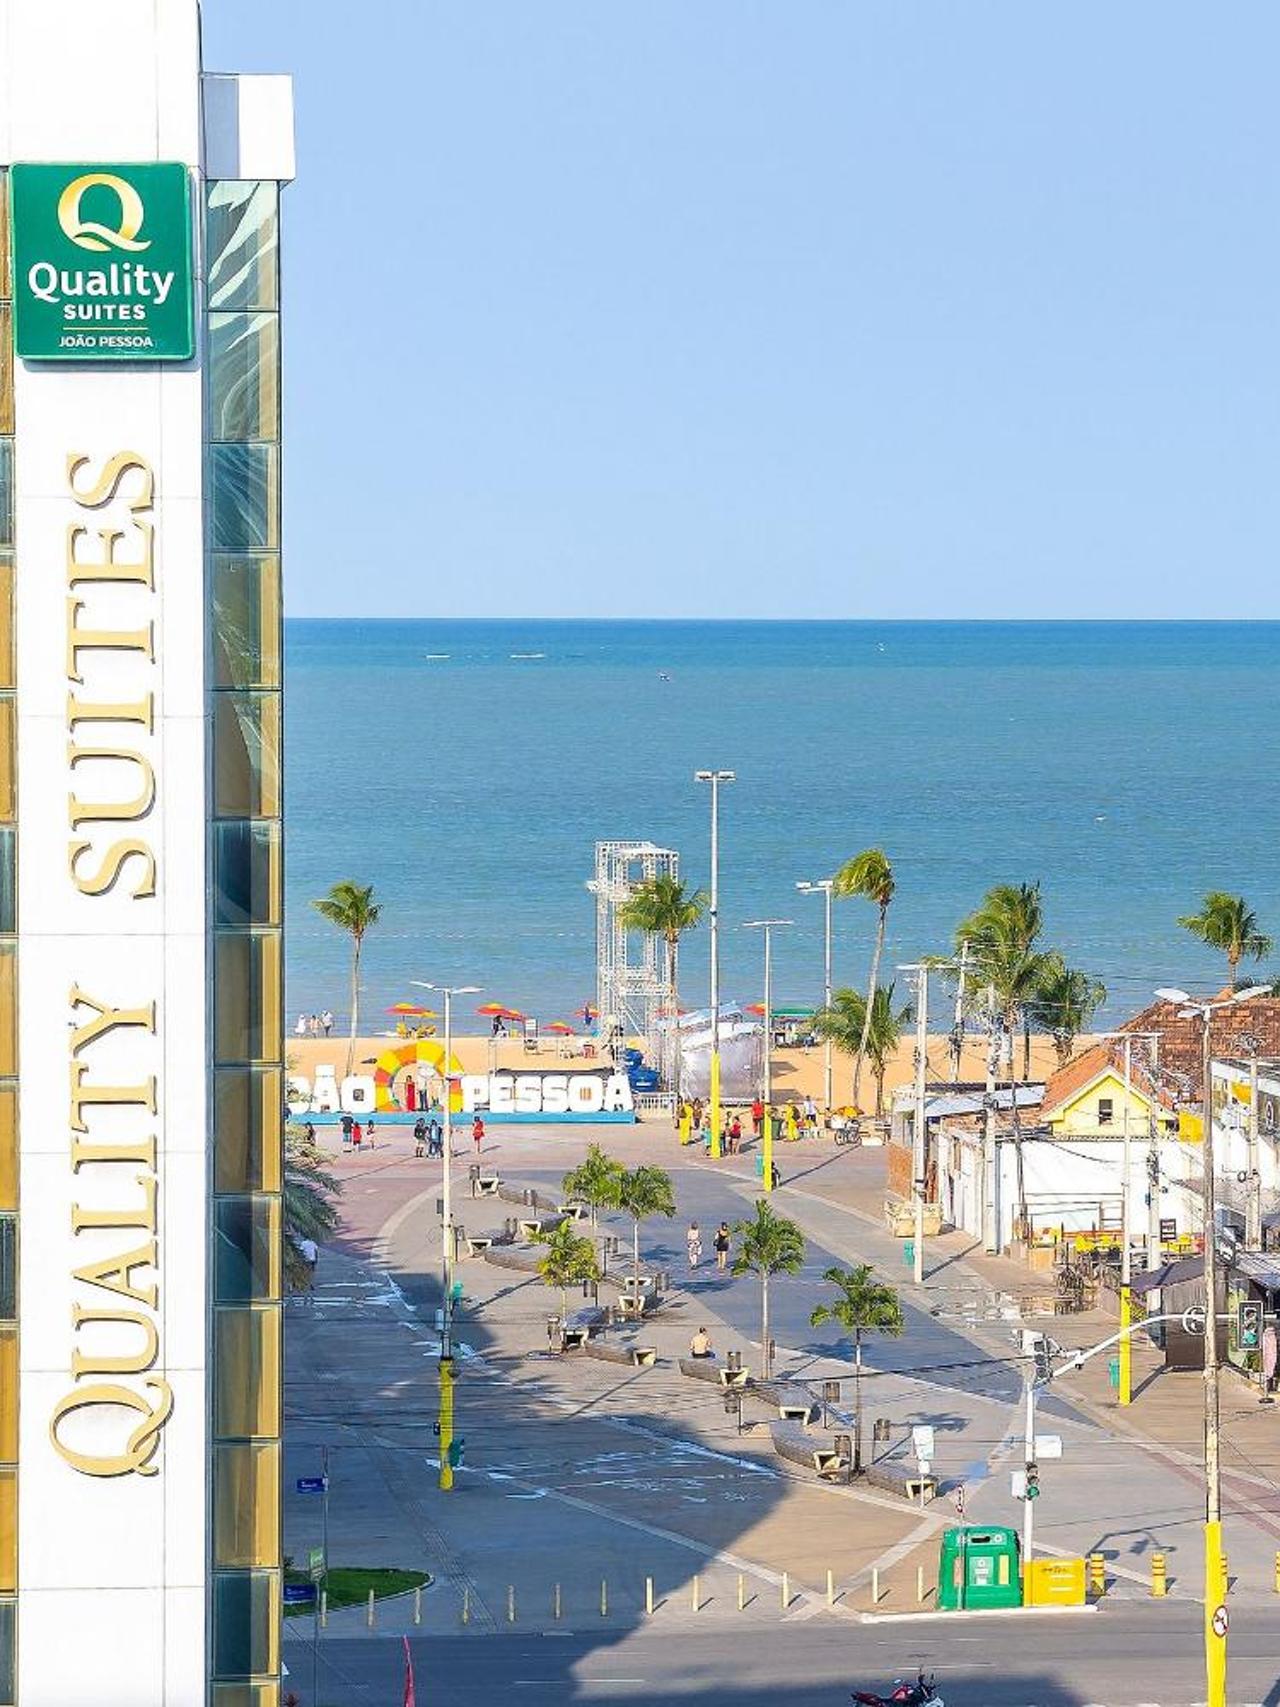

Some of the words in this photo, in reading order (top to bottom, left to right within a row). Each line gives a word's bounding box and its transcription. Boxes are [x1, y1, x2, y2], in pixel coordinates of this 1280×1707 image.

[28, 262, 175, 305] Quality
[63, 304, 146, 320] SUITES
[59, 333, 96, 348] JOÃO
[99, 335, 154, 348] PESSOA
[67, 449, 156, 900] SUITES
[463, 1068, 635, 1113] PESSOA
[49, 980, 175, 1478] QUALITY
